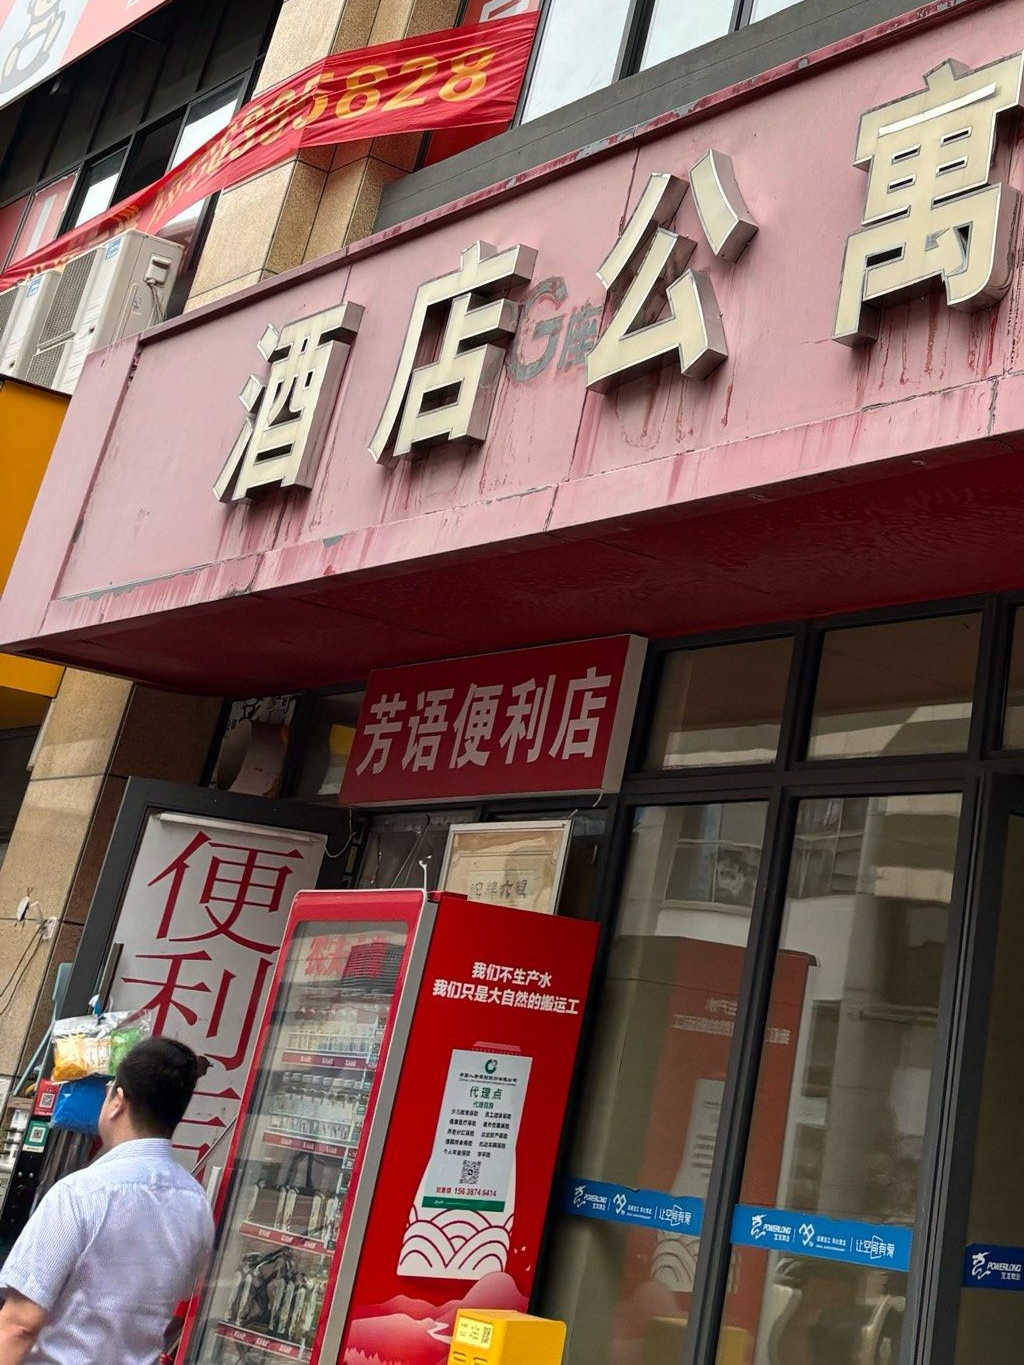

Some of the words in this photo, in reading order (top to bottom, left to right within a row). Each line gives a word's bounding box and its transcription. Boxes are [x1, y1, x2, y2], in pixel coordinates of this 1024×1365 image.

[355, 666, 612, 776] 芳语便利店
[472, 961, 553, 989] 我们不生产水
[432, 978, 580, 1015] 我们只是大自然的搬运工
